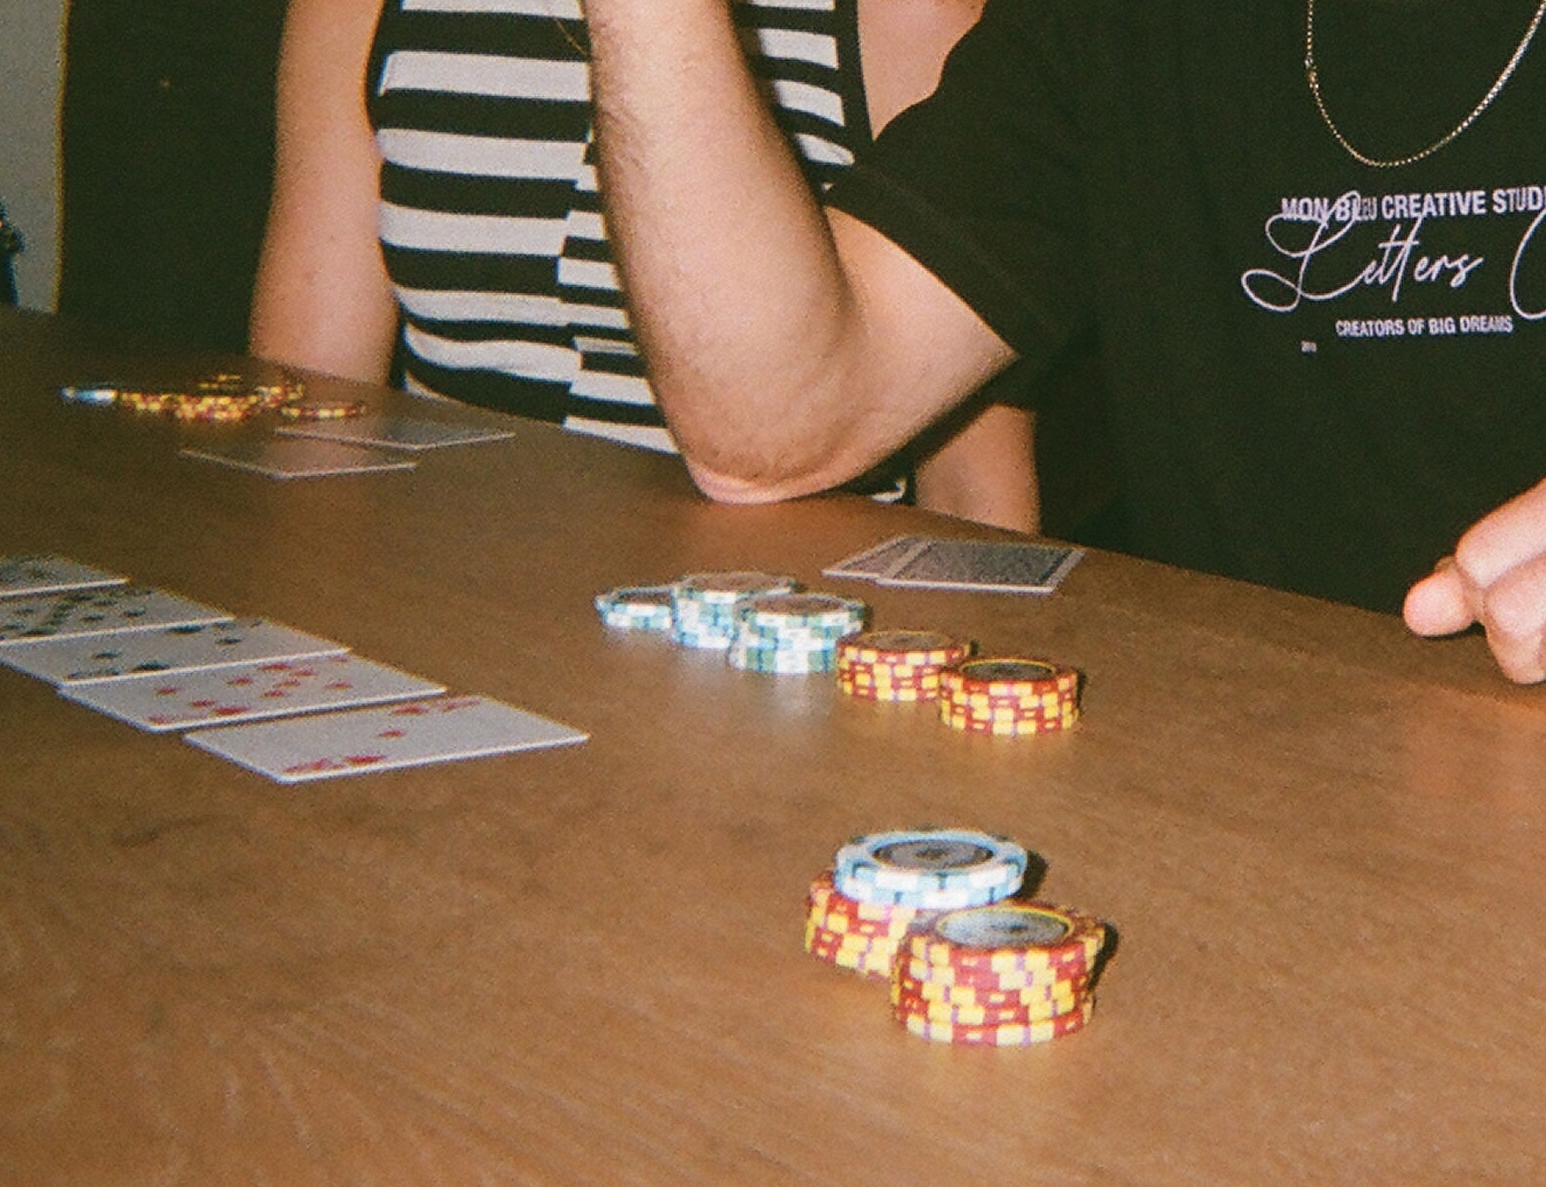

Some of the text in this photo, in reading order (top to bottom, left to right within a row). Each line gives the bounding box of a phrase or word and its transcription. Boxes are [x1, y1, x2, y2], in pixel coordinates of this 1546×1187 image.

[1381, 191, 1486, 220] CREATIVE
[1241, 190, 1483, 312] Letters
[1335, 315, 1513, 337] CREATORS OF BIG DREAMS
